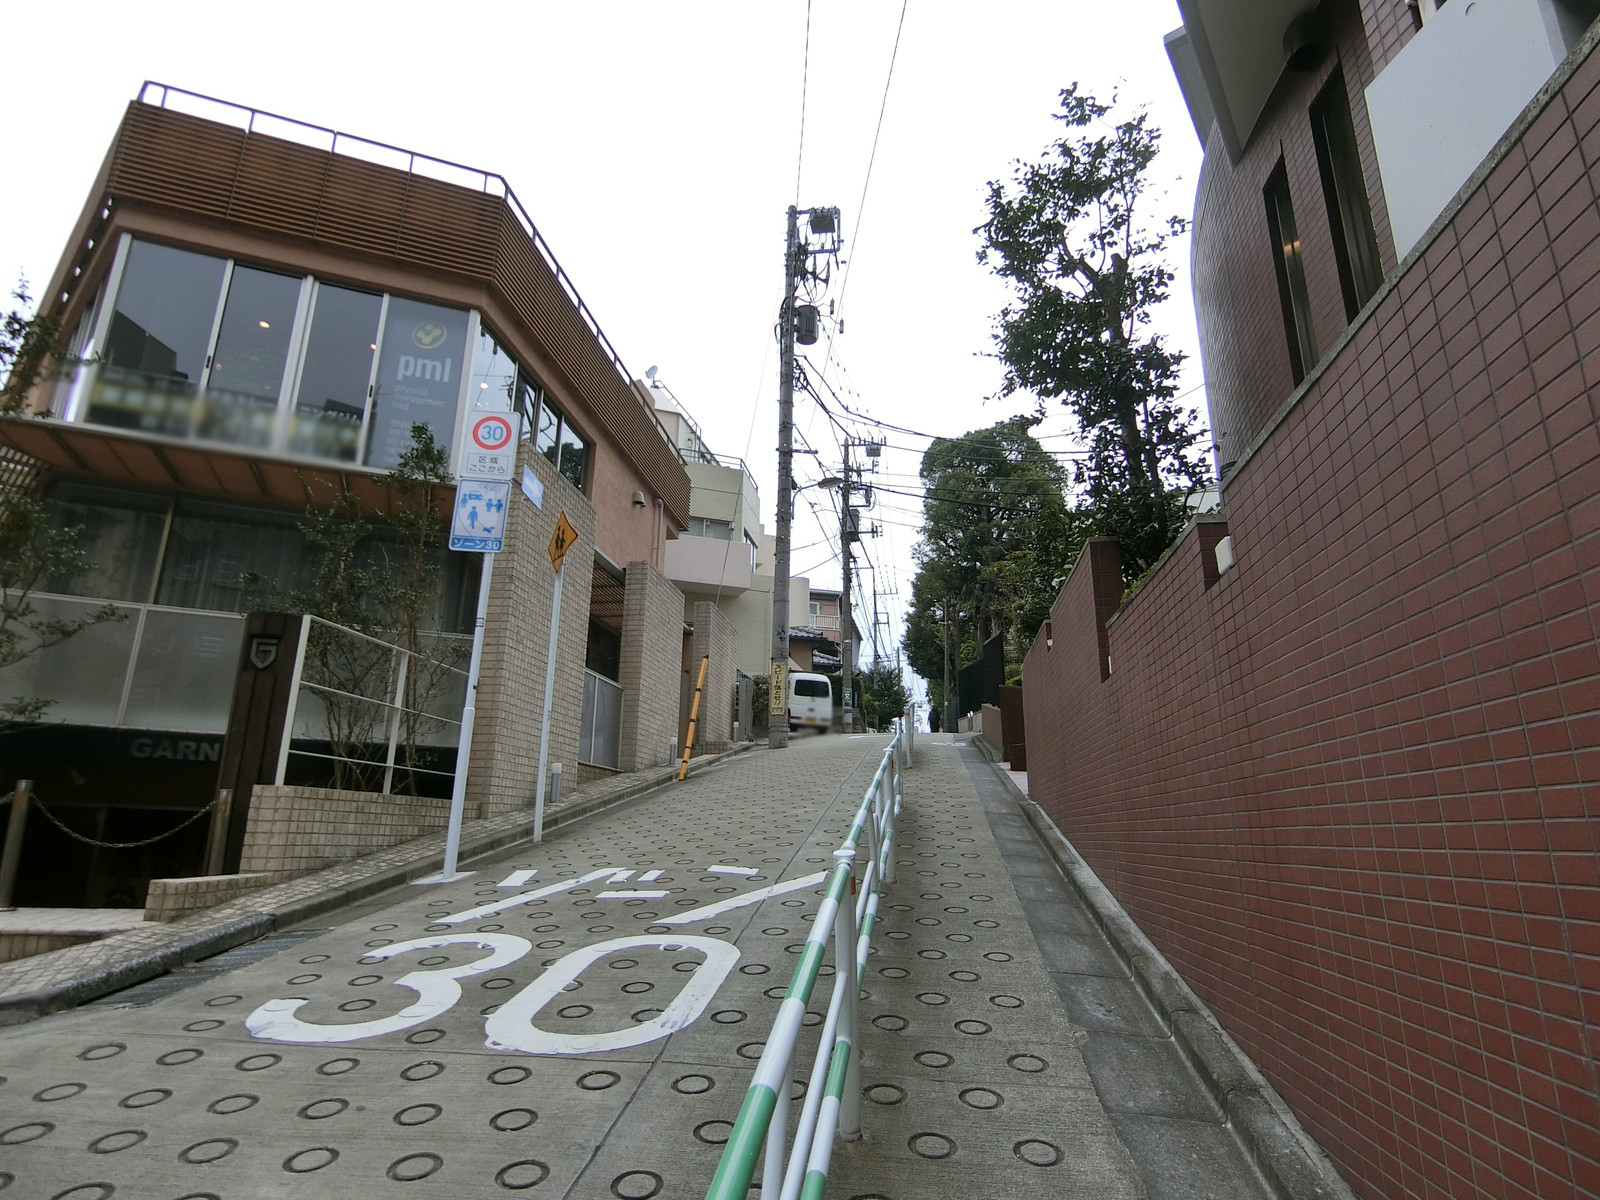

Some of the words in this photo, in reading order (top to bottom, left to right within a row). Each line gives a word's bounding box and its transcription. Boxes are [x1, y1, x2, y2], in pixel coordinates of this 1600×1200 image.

[397, 355, 452, 383] pml
[395, 384, 429, 396] physical
[393, 393, 446, 408] management
[481, 425, 504, 441] 30
[478, 455, 499, 465] 区域
[469, 464, 506, 474] ここから
[454, 538, 500, 550] ゾーン30
[434, 865, 828, 926] ゾーン
[244, 931, 742, 1055] 30
